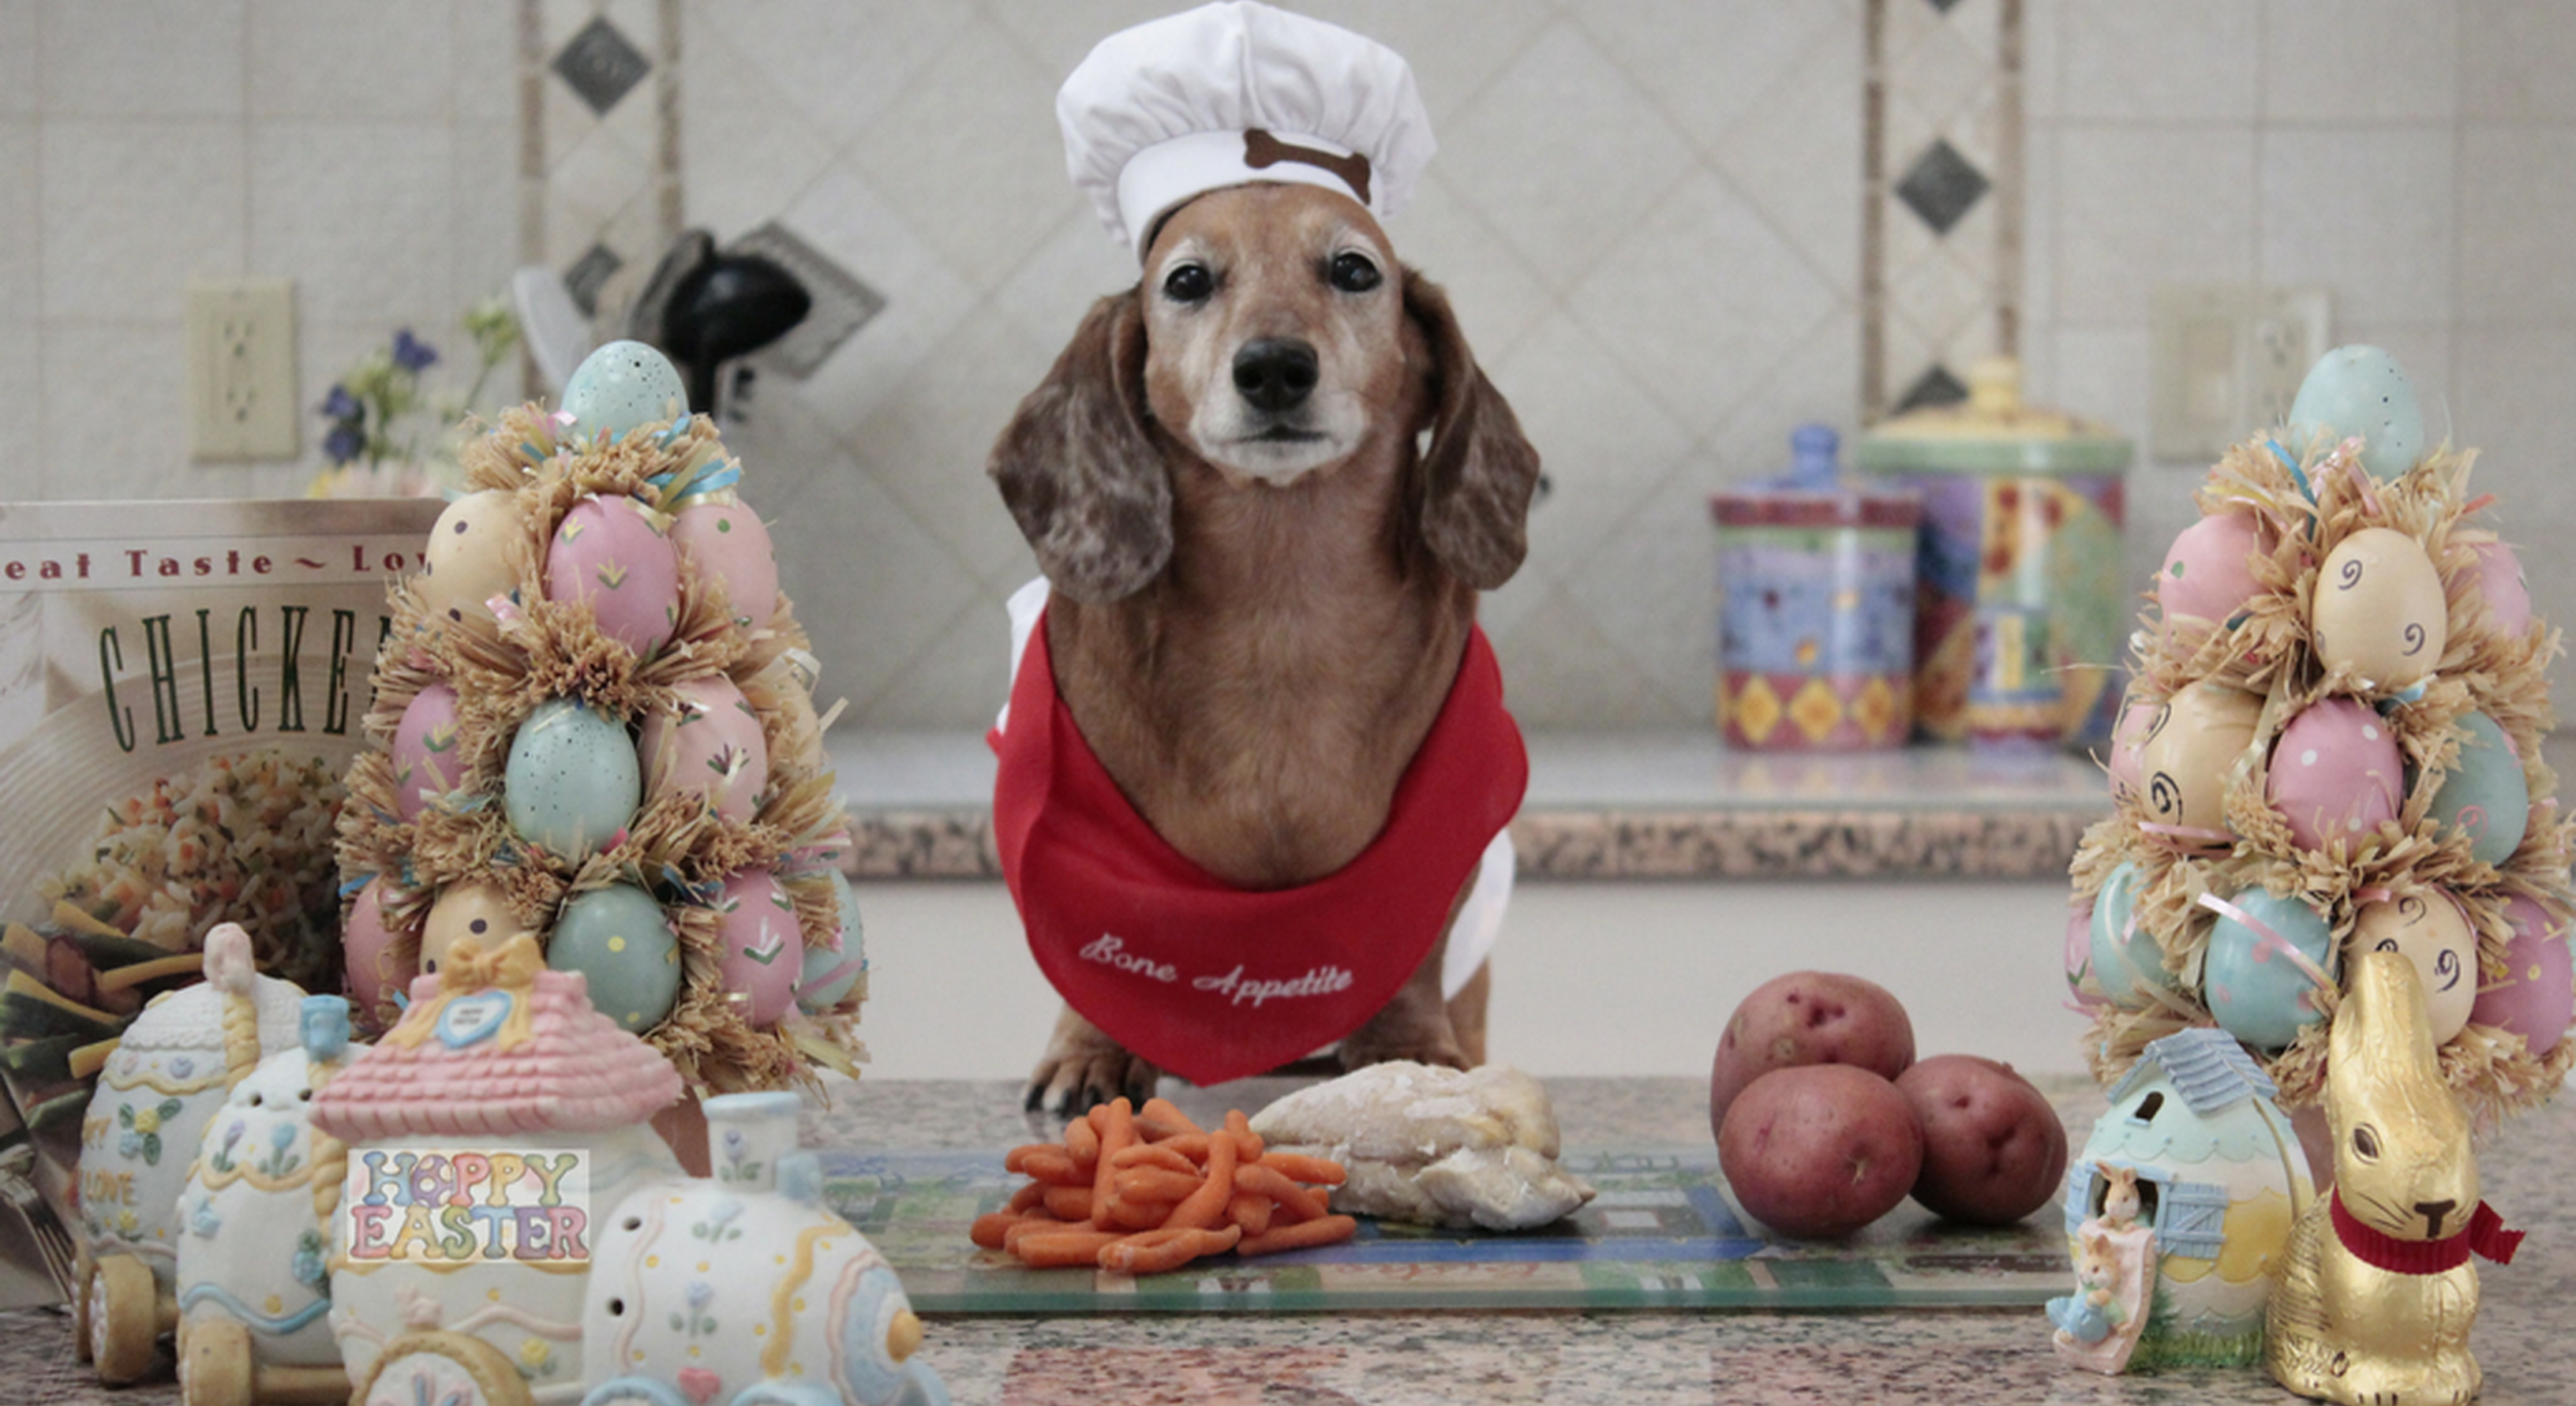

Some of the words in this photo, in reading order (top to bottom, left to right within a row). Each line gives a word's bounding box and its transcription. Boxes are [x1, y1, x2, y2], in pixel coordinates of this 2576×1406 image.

[2, 552, 91, 581] eat
[125, 549, 272, 578] Taste
[99, 605, 391, 753] CHICKE
[1079, 932, 1178, 982] Bone
[1192, 965, 1353, 1008] Appetite
